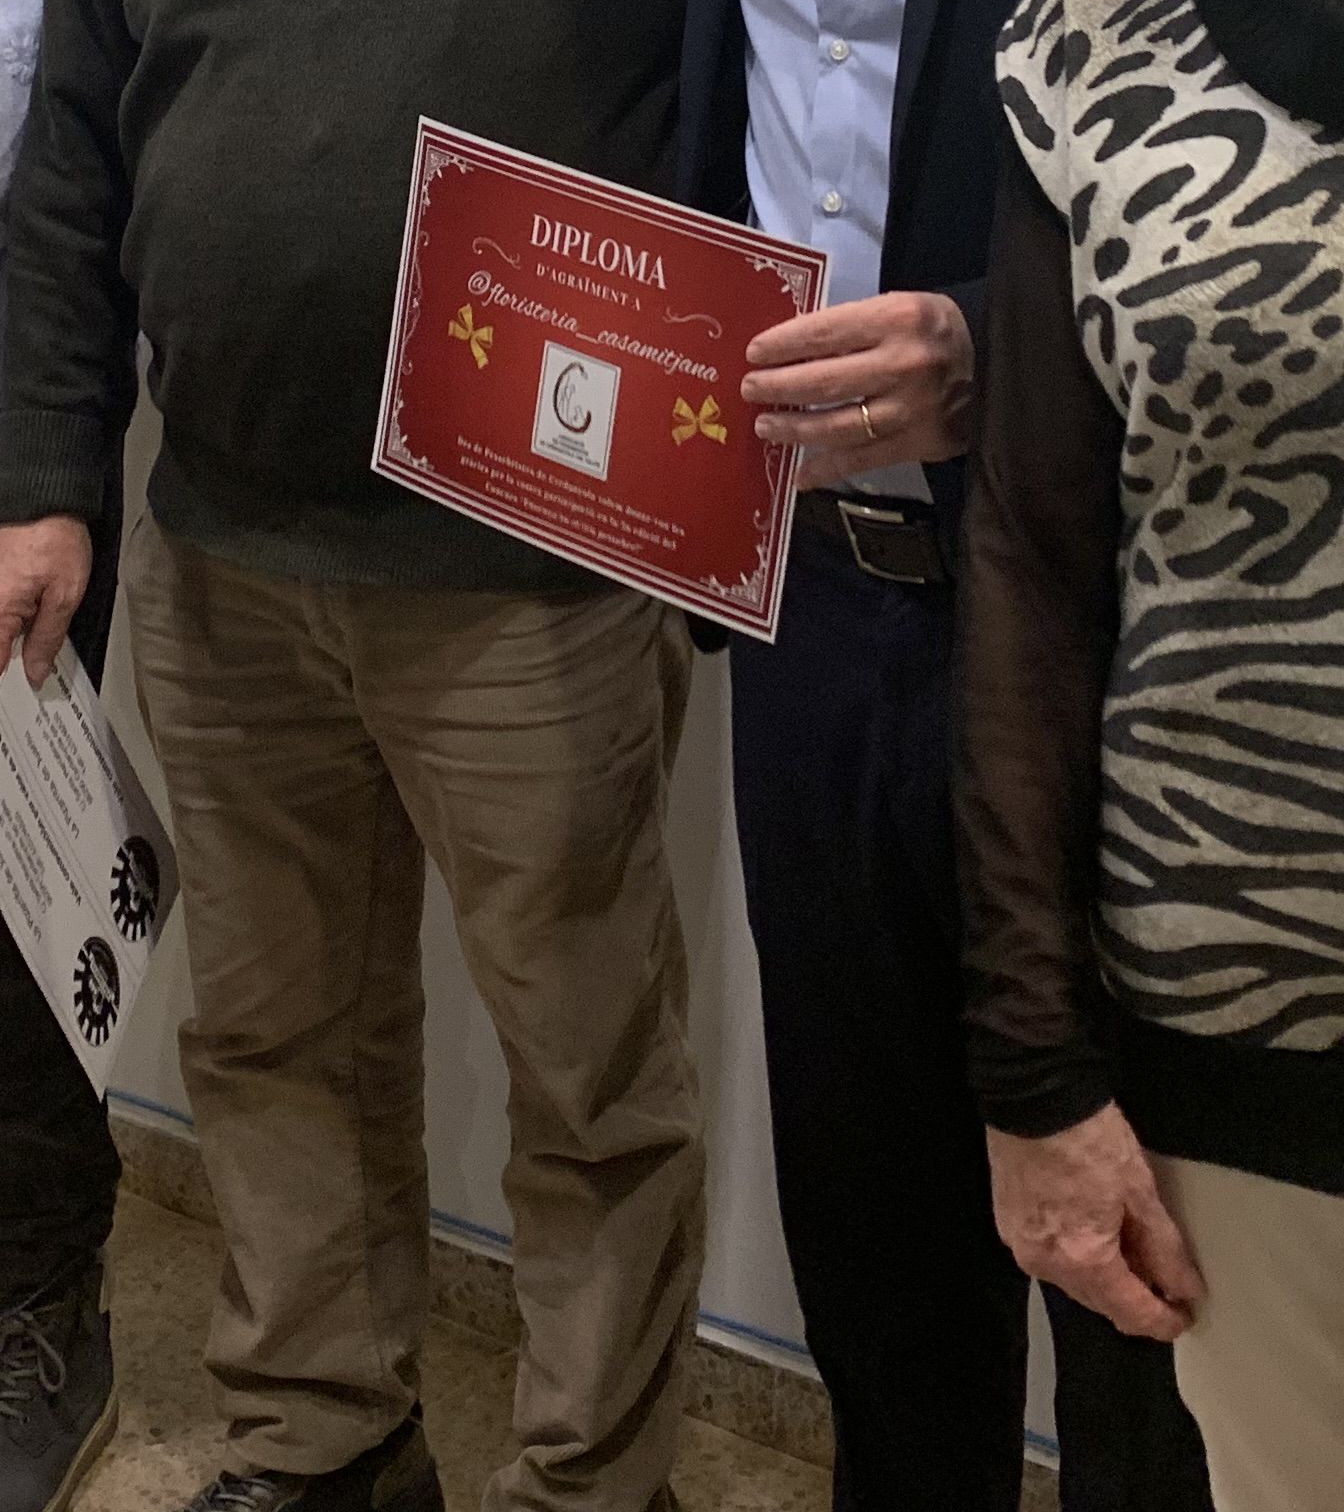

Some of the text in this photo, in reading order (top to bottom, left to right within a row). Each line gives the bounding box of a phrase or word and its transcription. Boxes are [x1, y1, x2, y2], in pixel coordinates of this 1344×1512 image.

[529, 213, 668, 290] DIPLOMA
[536, 263, 642, 311] D'AGRAÏMENT A
